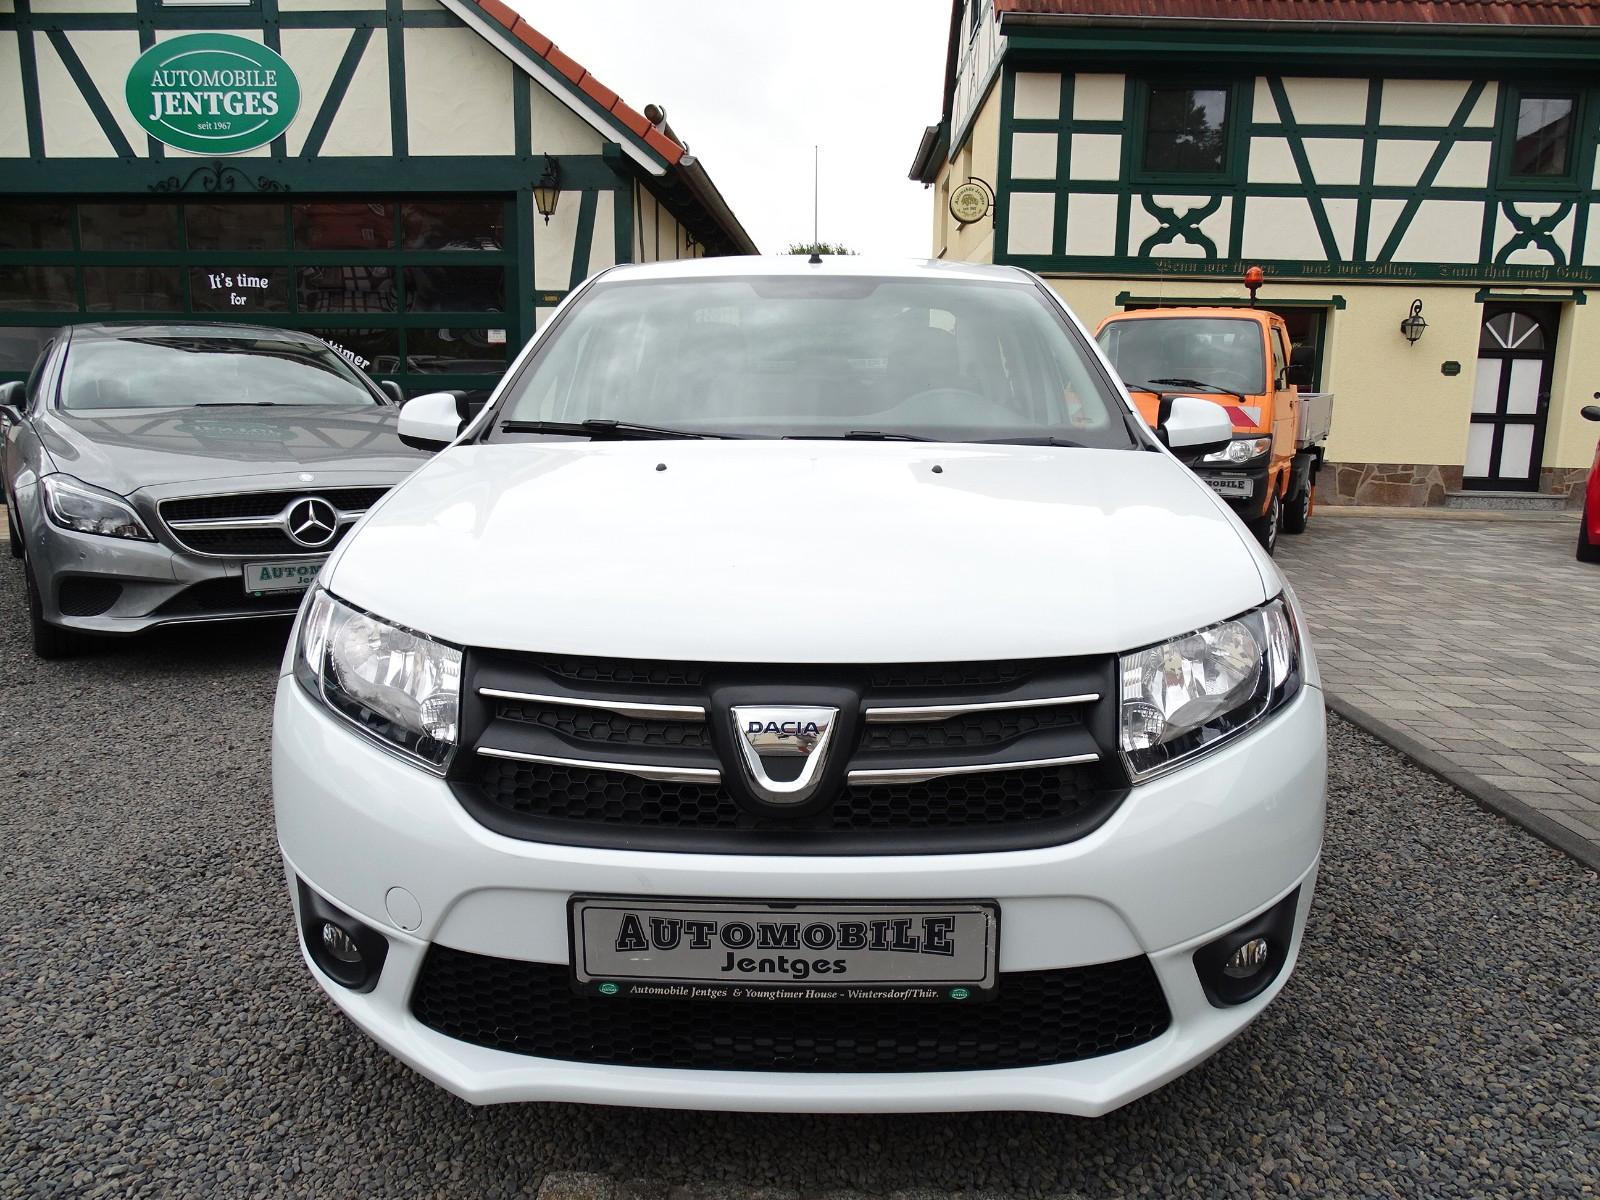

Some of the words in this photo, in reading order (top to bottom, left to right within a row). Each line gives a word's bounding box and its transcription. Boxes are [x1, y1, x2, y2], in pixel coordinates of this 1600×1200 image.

[151, 70, 277, 87] AUTOMOBILE
[149, 91, 279, 121] JENTGES
[197, 122, 212, 130] seit
[214, 122, 231, 130] 1967
[208, 273, 233, 289] It's
[236, 273, 269, 289] time
[230, 293, 247, 305] for
[748, 721, 820, 735] DACIA
[615, 912, 956, 957] AUTOMOBILE
[721, 952, 847, 979] Jentges
[630, 985, 689, 996] Automobile
[690, 986, 727, 999] Jentges
[733, 988, 743, 996] &
[745, 988, 803, 1000] Youngtimer
[805, 989, 837, 999] House
[848, 988, 939, 1000] Wintersdorf/Thür.
